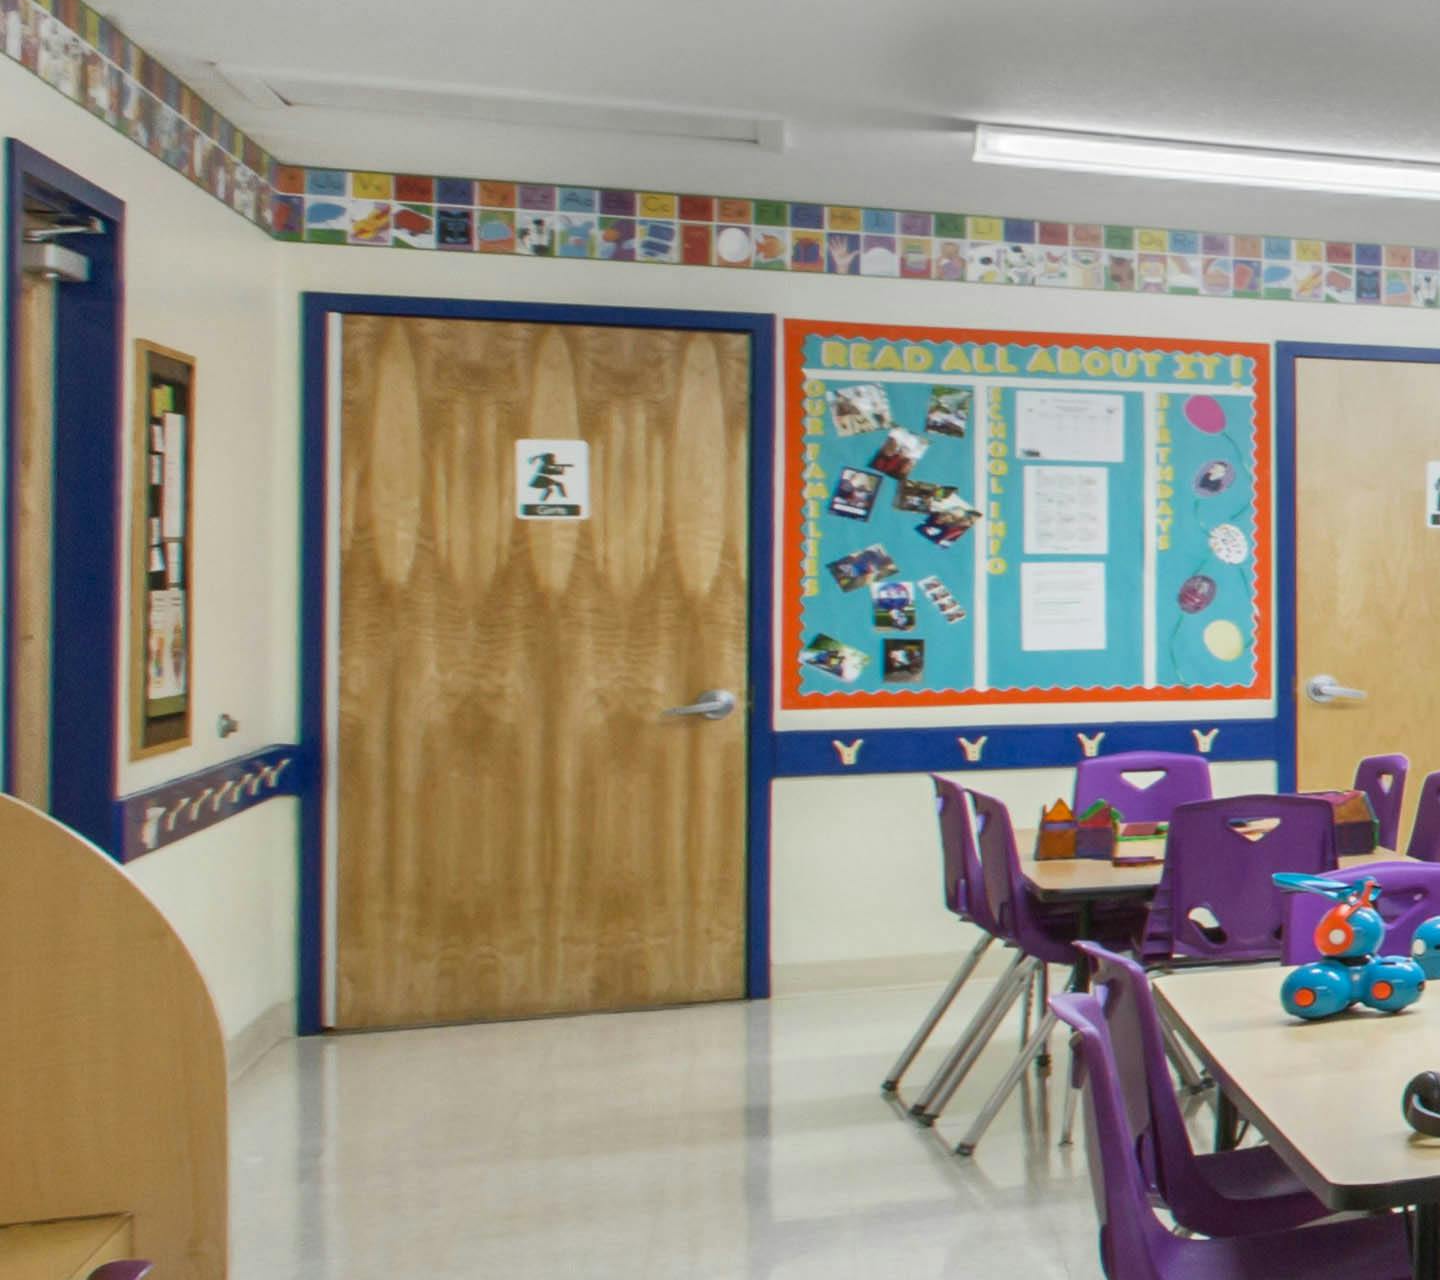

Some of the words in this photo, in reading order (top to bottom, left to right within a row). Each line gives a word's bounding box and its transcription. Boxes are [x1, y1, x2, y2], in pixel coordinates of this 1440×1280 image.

[821, 341, 935, 371] READ
[941, 346, 1018, 373] ALL
[1026, 346, 1162, 378] ABOUT
